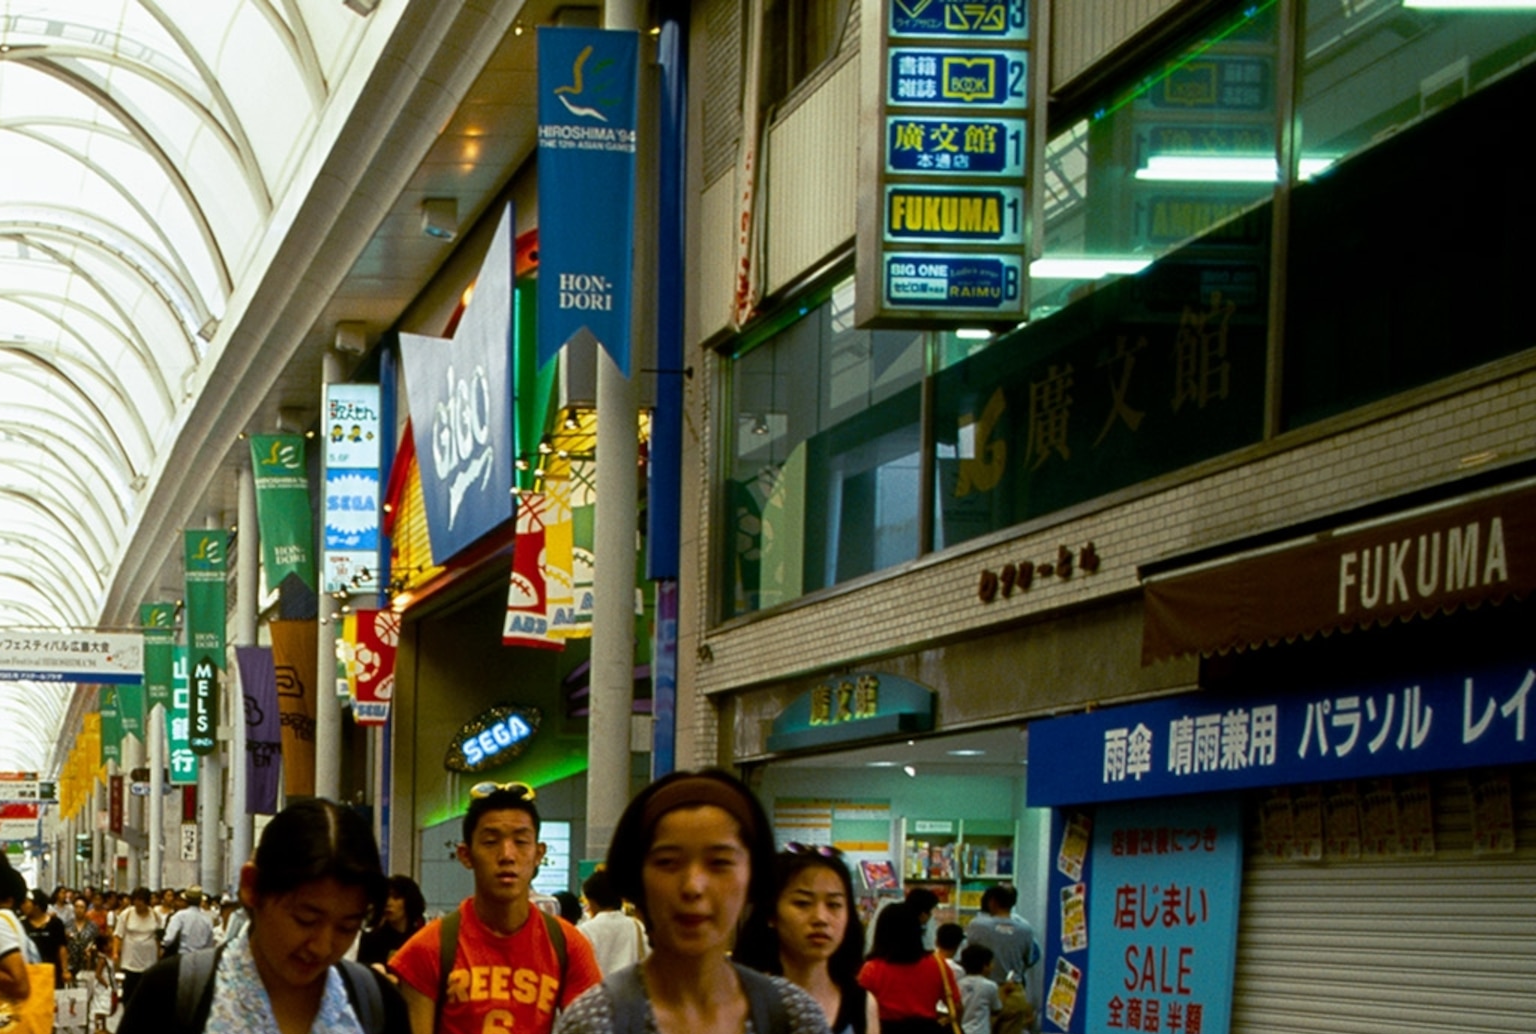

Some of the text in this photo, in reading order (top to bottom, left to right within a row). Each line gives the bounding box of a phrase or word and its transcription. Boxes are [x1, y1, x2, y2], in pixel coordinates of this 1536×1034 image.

[898, 57, 936, 76] 書籍
[1010, 62, 1025, 97] 2
[898, 79, 936, 98] 雑誌
[951, 77, 988, 92] BOOK
[538, 125, 616, 141] HIROSHIMA
[539, 139, 557, 148] THE
[578, 141, 604, 150] ASIAN
[605, 142, 636, 153] GAMES
[894, 123, 998, 153] 廣文館
[1010, 130, 1021, 166] 1
[916, 153, 969, 169] 本通店
[891, 195, 1000, 233] FUKUMA
[1007, 197, 1018, 234] 1
[559, 273, 612, 291] HON-
[890, 263, 917, 277] BIG
[918, 264, 949, 277] ONE
[559, 292, 612, 311] DORI
[949, 285, 1001, 299] RAIMU
[327, 495, 376, 511] SEGA
[275, 554, 306, 565] DORI
[1337, 516, 1509, 615] FUKUMA
[194, 663, 212, 732] MELS
[461, 713, 533, 766] SEGA
[1102, 668, 1536, 784] 雨傘 晴雨兼用 パラソル レイ
[1111, 824, 1218, 857] 店舗改装につき
[1113, 883, 1208, 930] 店じまい
[1123, 944, 1194, 996] SALE
[1107, 995, 1160, 1034] 全商品
